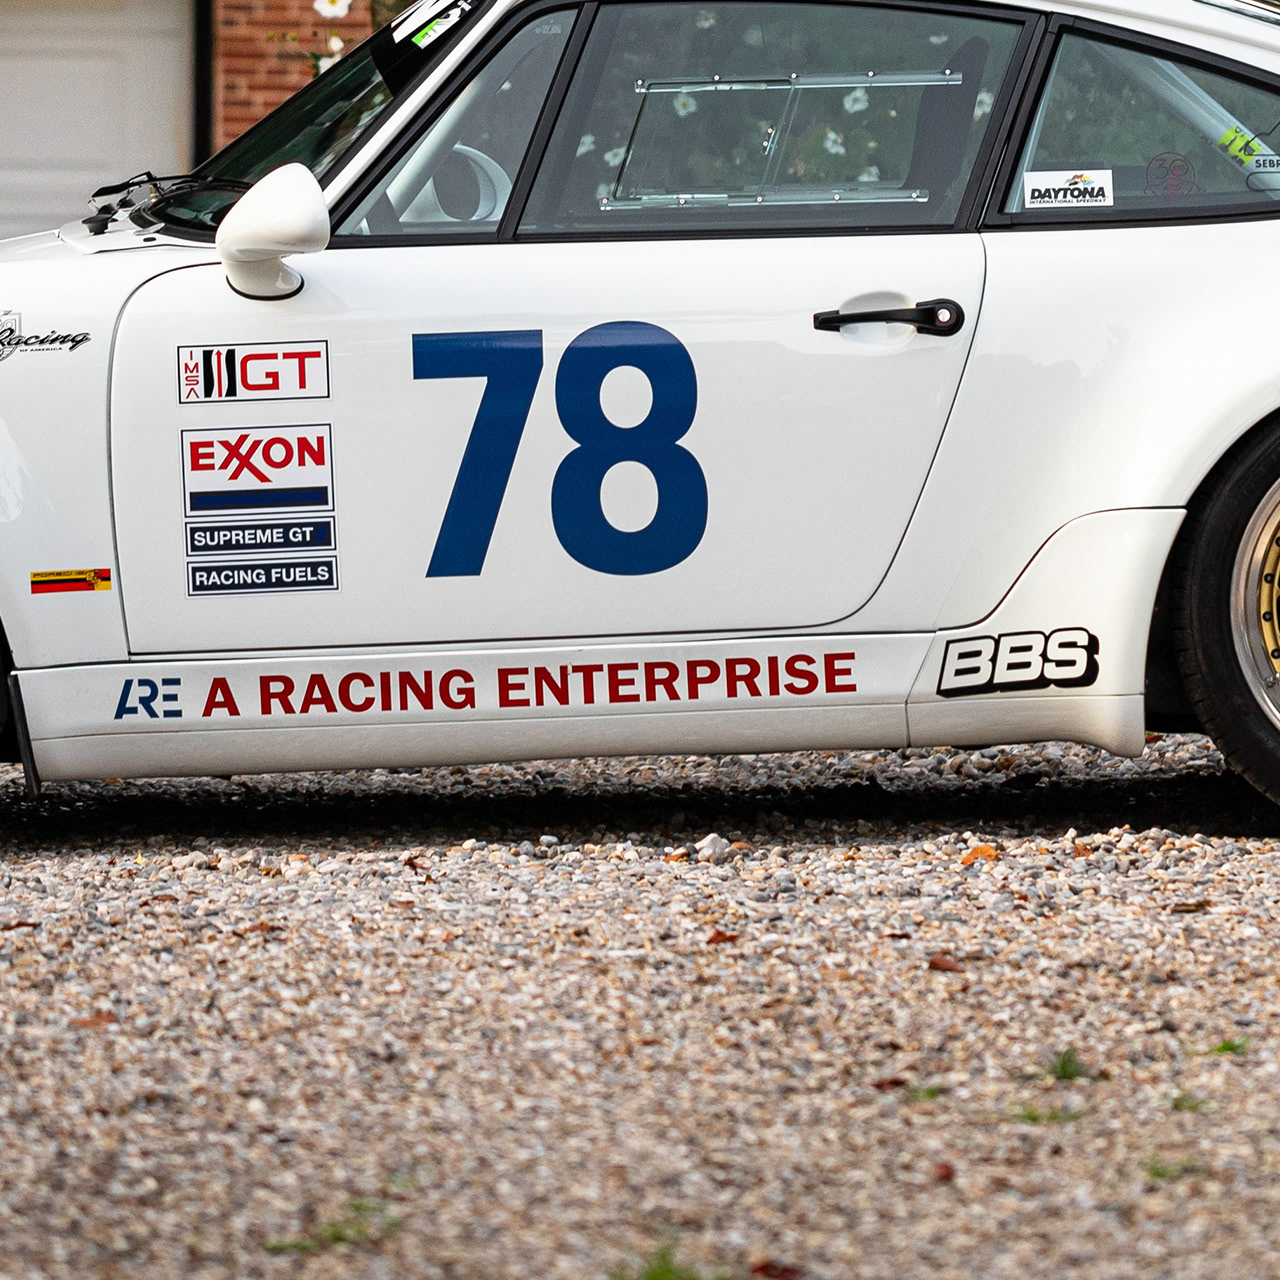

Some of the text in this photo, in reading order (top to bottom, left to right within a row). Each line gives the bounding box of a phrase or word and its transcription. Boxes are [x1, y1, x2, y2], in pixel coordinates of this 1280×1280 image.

[1030, 187, 1106, 200] DAYTONA
[240, 350, 322, 392] GT
[190, 434, 326, 483] EXXON
[413, 322, 706, 576] 78
[194, 526, 314, 546] SUPREME GT
[195, 566, 330, 586] RACING FUELS
[115, 652, 857, 718] ARE A RACING ENTERPRISE
[937, 627, 1099, 698] BBS
